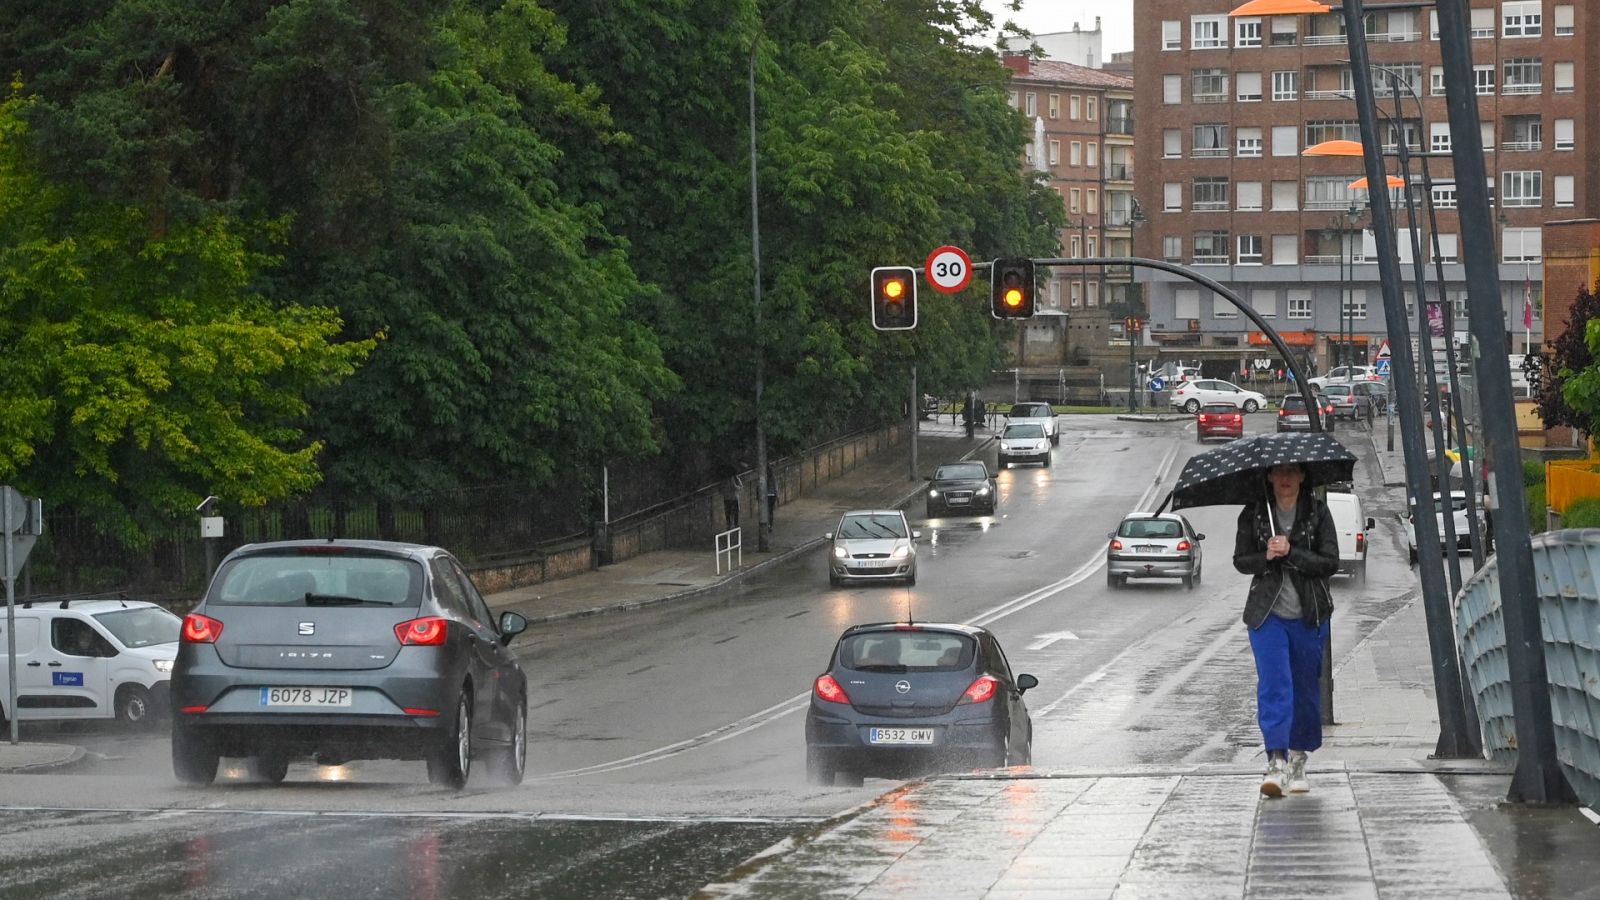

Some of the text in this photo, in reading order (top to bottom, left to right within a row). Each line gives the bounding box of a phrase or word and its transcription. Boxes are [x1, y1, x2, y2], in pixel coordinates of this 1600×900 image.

[936, 262, 961, 277] 30
[271, 689, 348, 704] 6078 JZP
[878, 730, 931, 740] 6532 GMV
